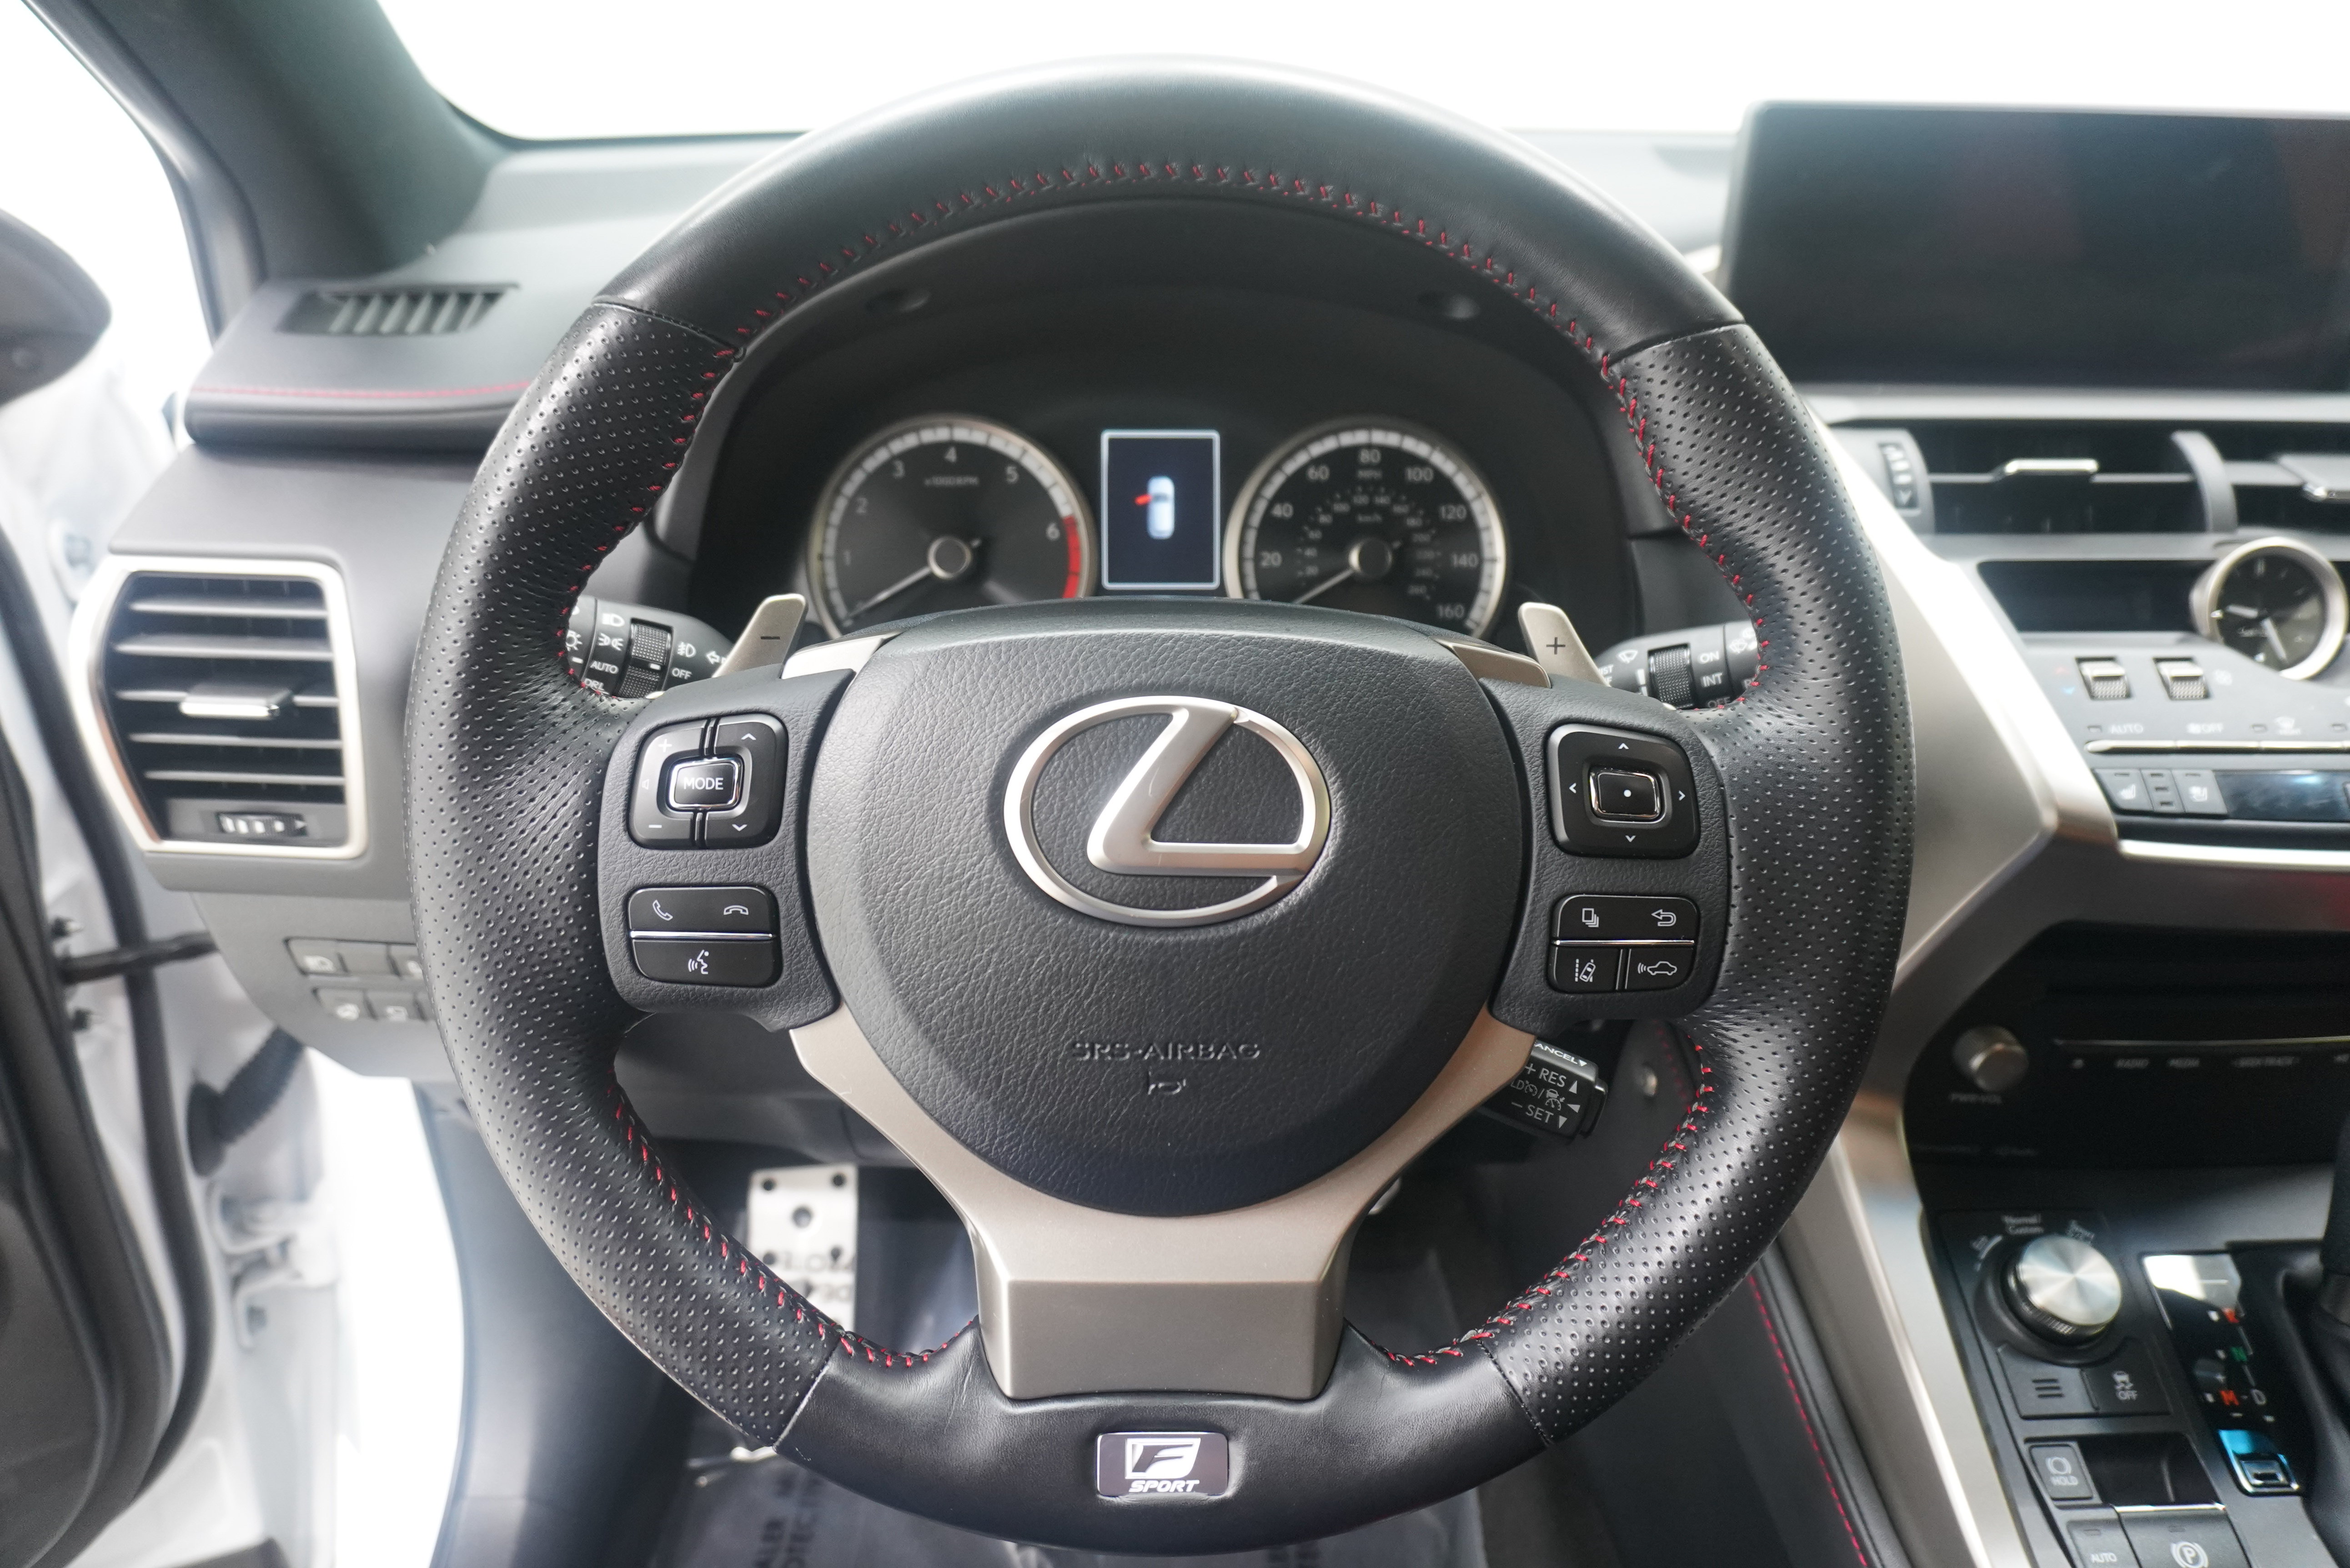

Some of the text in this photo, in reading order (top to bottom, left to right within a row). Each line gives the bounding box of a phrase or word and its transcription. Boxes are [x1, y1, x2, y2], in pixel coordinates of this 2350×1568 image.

[944, 447, 957, 463] 4
[1360, 449, 1381, 464] 80
[893, 461, 905, 478] 3
[1006, 466, 1018, 483] 5
[1307, 466, 1329, 481] 60
[1405, 467, 1433, 482] 100
[857, 498, 869, 513] 2
[1272, 503, 1294, 518] 40
[1439, 504, 1467, 520] 120
[1047, 523, 1060, 541] 6
[843, 549, 850, 565] 1
[1260, 552, 1282, 567] 20
[1451, 552, 1478, 568] 140
[1437, 603, 1464, 619] 160
[1700, 651, 1719, 664] ON
[590, 661, 619, 674] AUTO
[672, 667, 692, 679] OFF
[584, 678, 605, 691] DRL
[1702, 673, 1723, 688] INT
[2110, 724, 2144, 734] AUTO
[683, 778, 724, 790] MODE
[1534, 1043, 1578, 1065] ANCEL
[1539, 1067, 1567, 1088] RES
[1526, 1105, 1554, 1123] SET
[1129, 1480, 1200, 1493] SPORT
[2051, 1475, 2079, 1486] HOLD
[2090, 1552, 2117, 1563] AUTO
